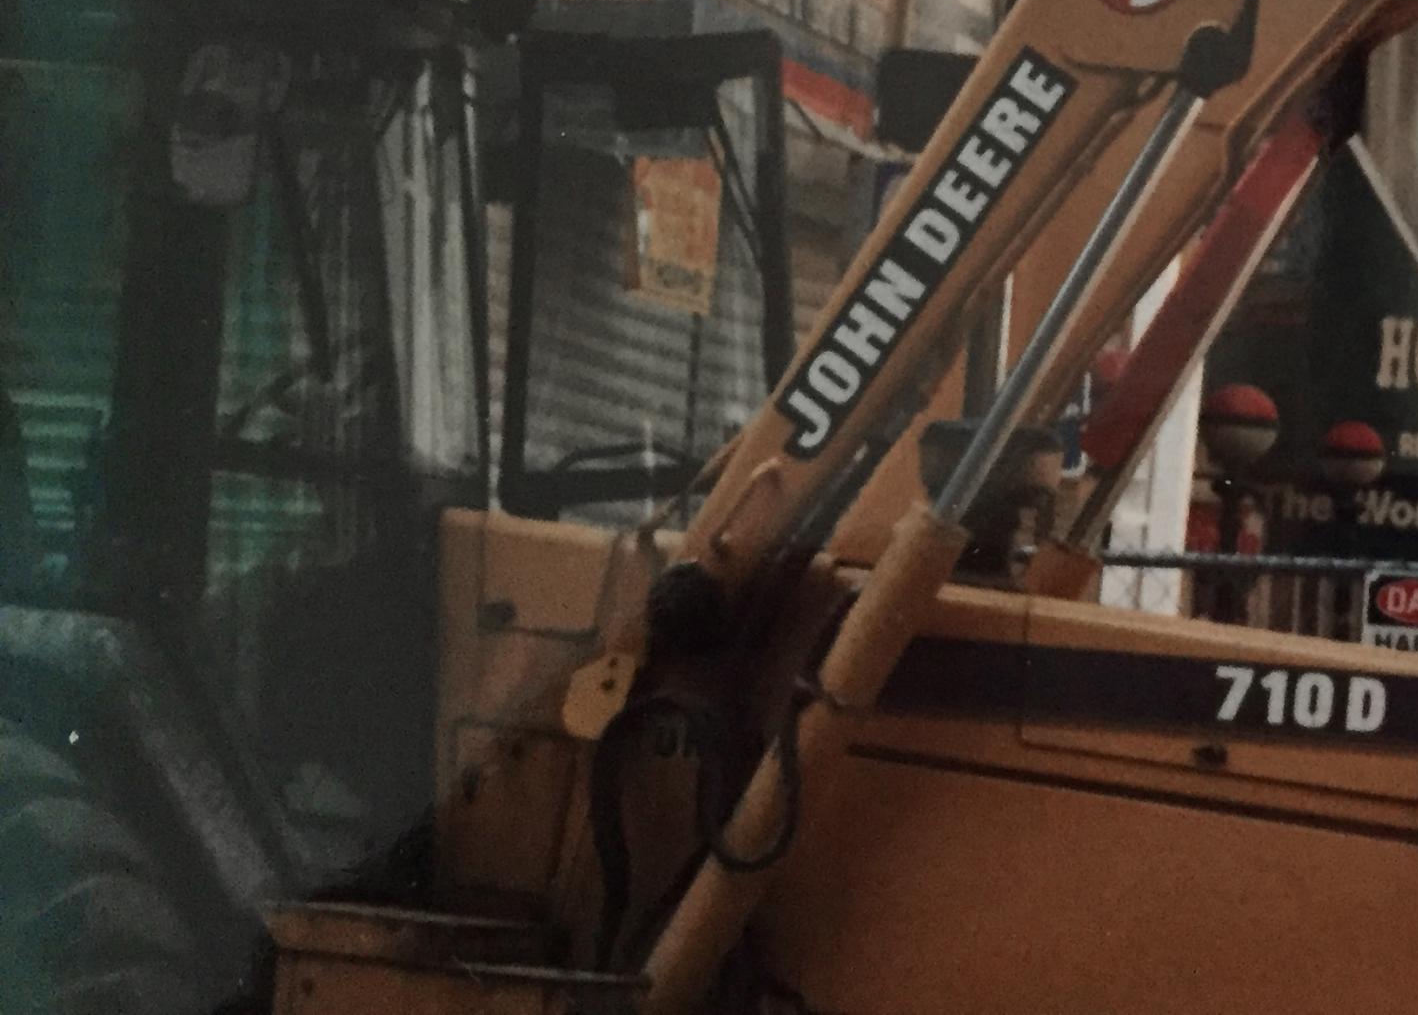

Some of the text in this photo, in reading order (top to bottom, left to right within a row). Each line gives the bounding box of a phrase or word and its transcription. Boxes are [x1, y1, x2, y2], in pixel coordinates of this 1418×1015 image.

[787, 59, 1065, 448] JOHN DEERE
[1216, 665, 1387, 733] 710 D
